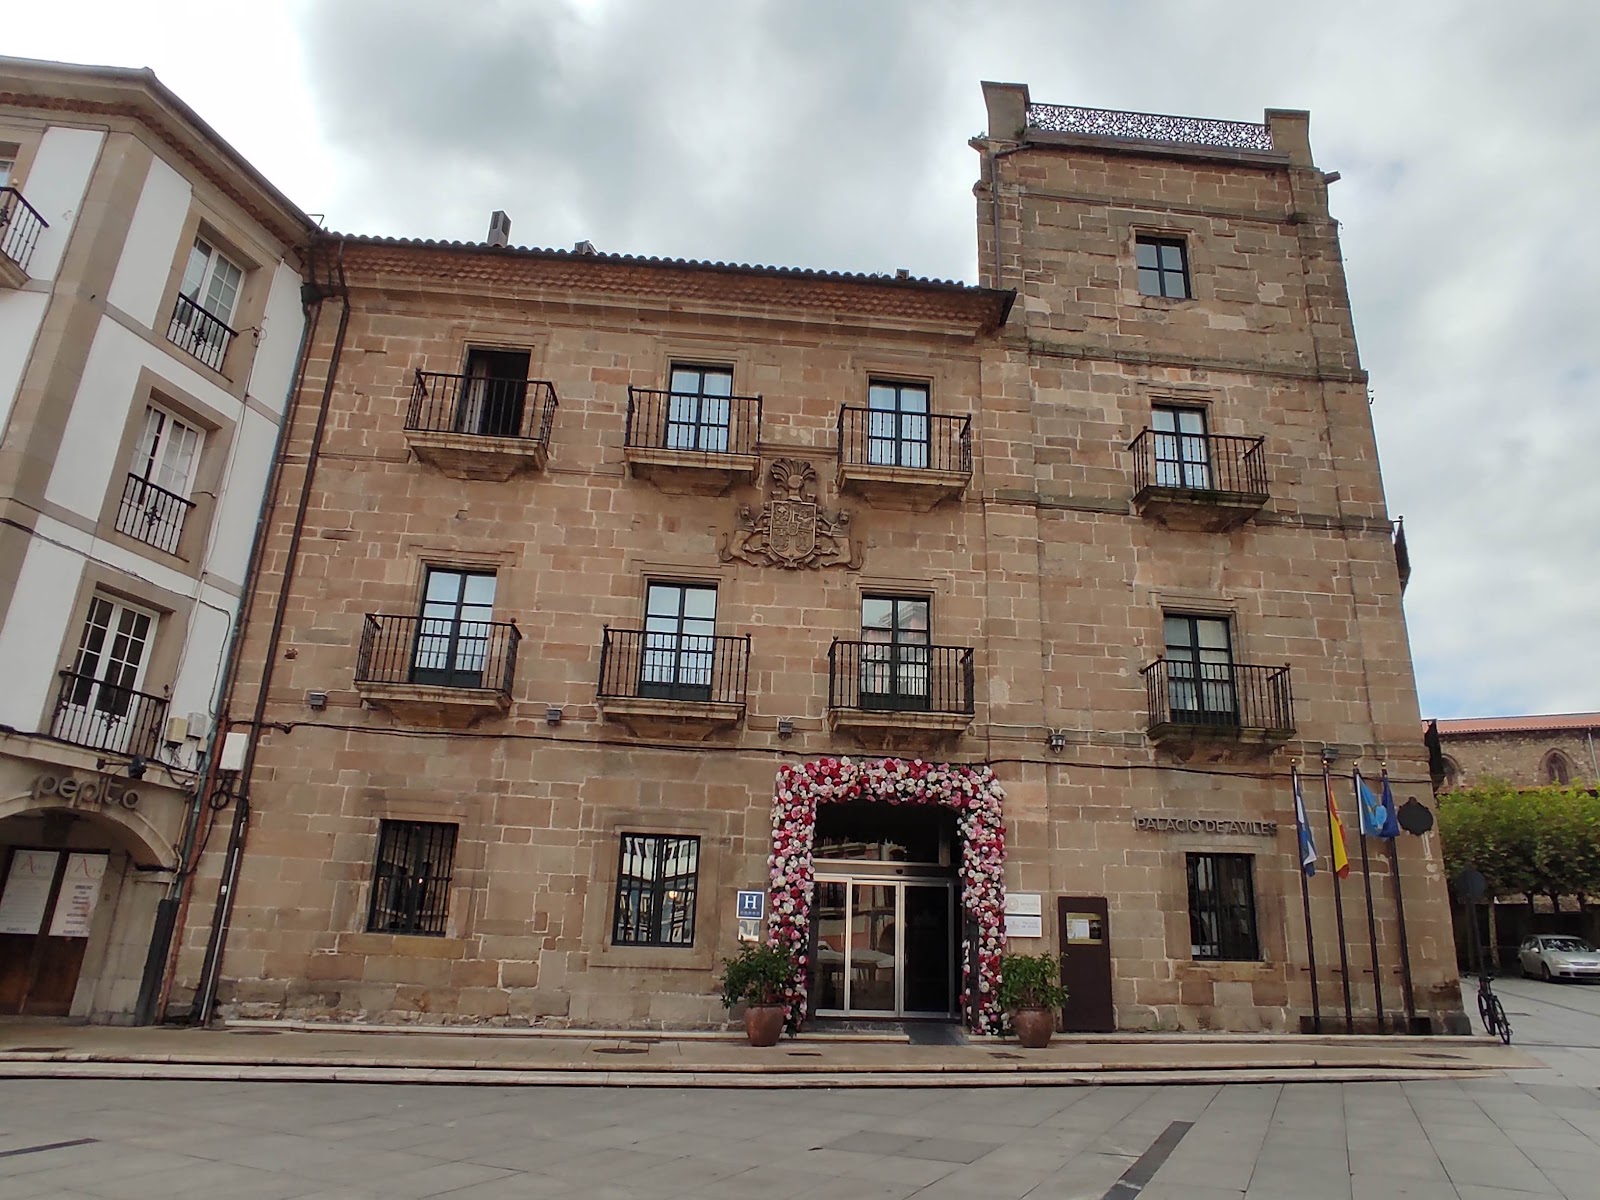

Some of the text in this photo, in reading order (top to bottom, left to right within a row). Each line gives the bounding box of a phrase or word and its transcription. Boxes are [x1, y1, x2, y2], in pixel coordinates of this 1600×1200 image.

[1135, 817, 1201, 834] PALACIO
[1205, 819, 1225, 834] DE
[744, 895, 757, 909] H
